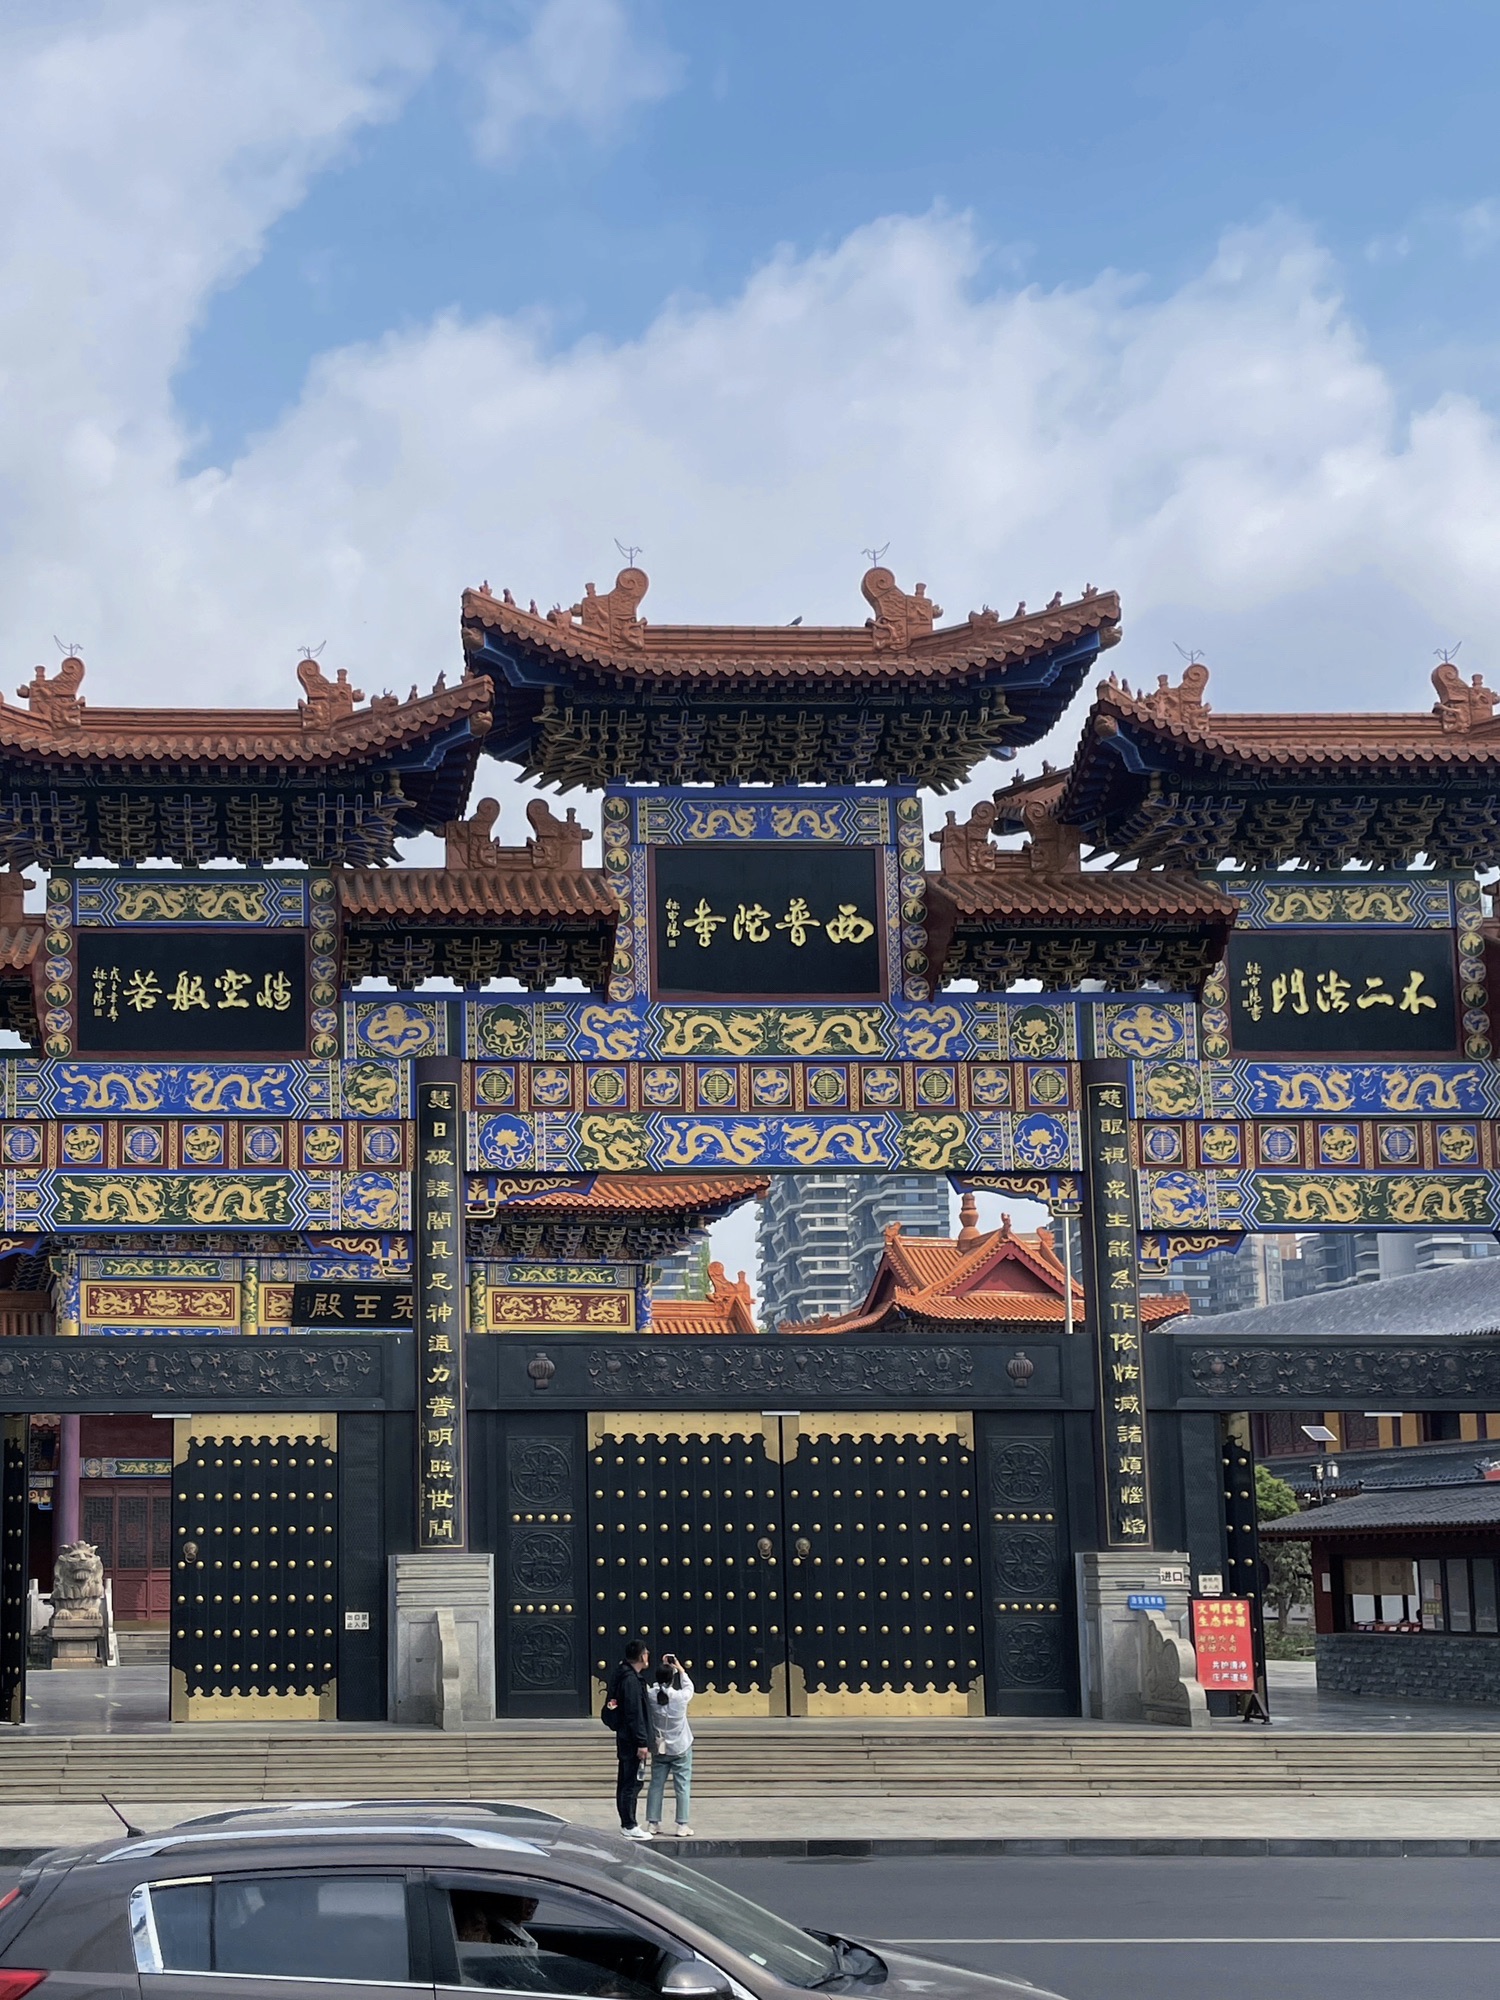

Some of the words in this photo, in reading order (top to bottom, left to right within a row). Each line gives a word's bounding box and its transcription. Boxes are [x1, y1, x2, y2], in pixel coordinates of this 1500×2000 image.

[683, 897, 875, 948] 西普陀寺
[123, 968, 292, 1012] 性空般若
[1271, 968, 1437, 1015] 不二法門
[1161, 1571, 1183, 1582] 进口
[1197, 1603, 1245, 1614] 文明敬香
[1198, 1616, 1246, 1627] 生态和谐
